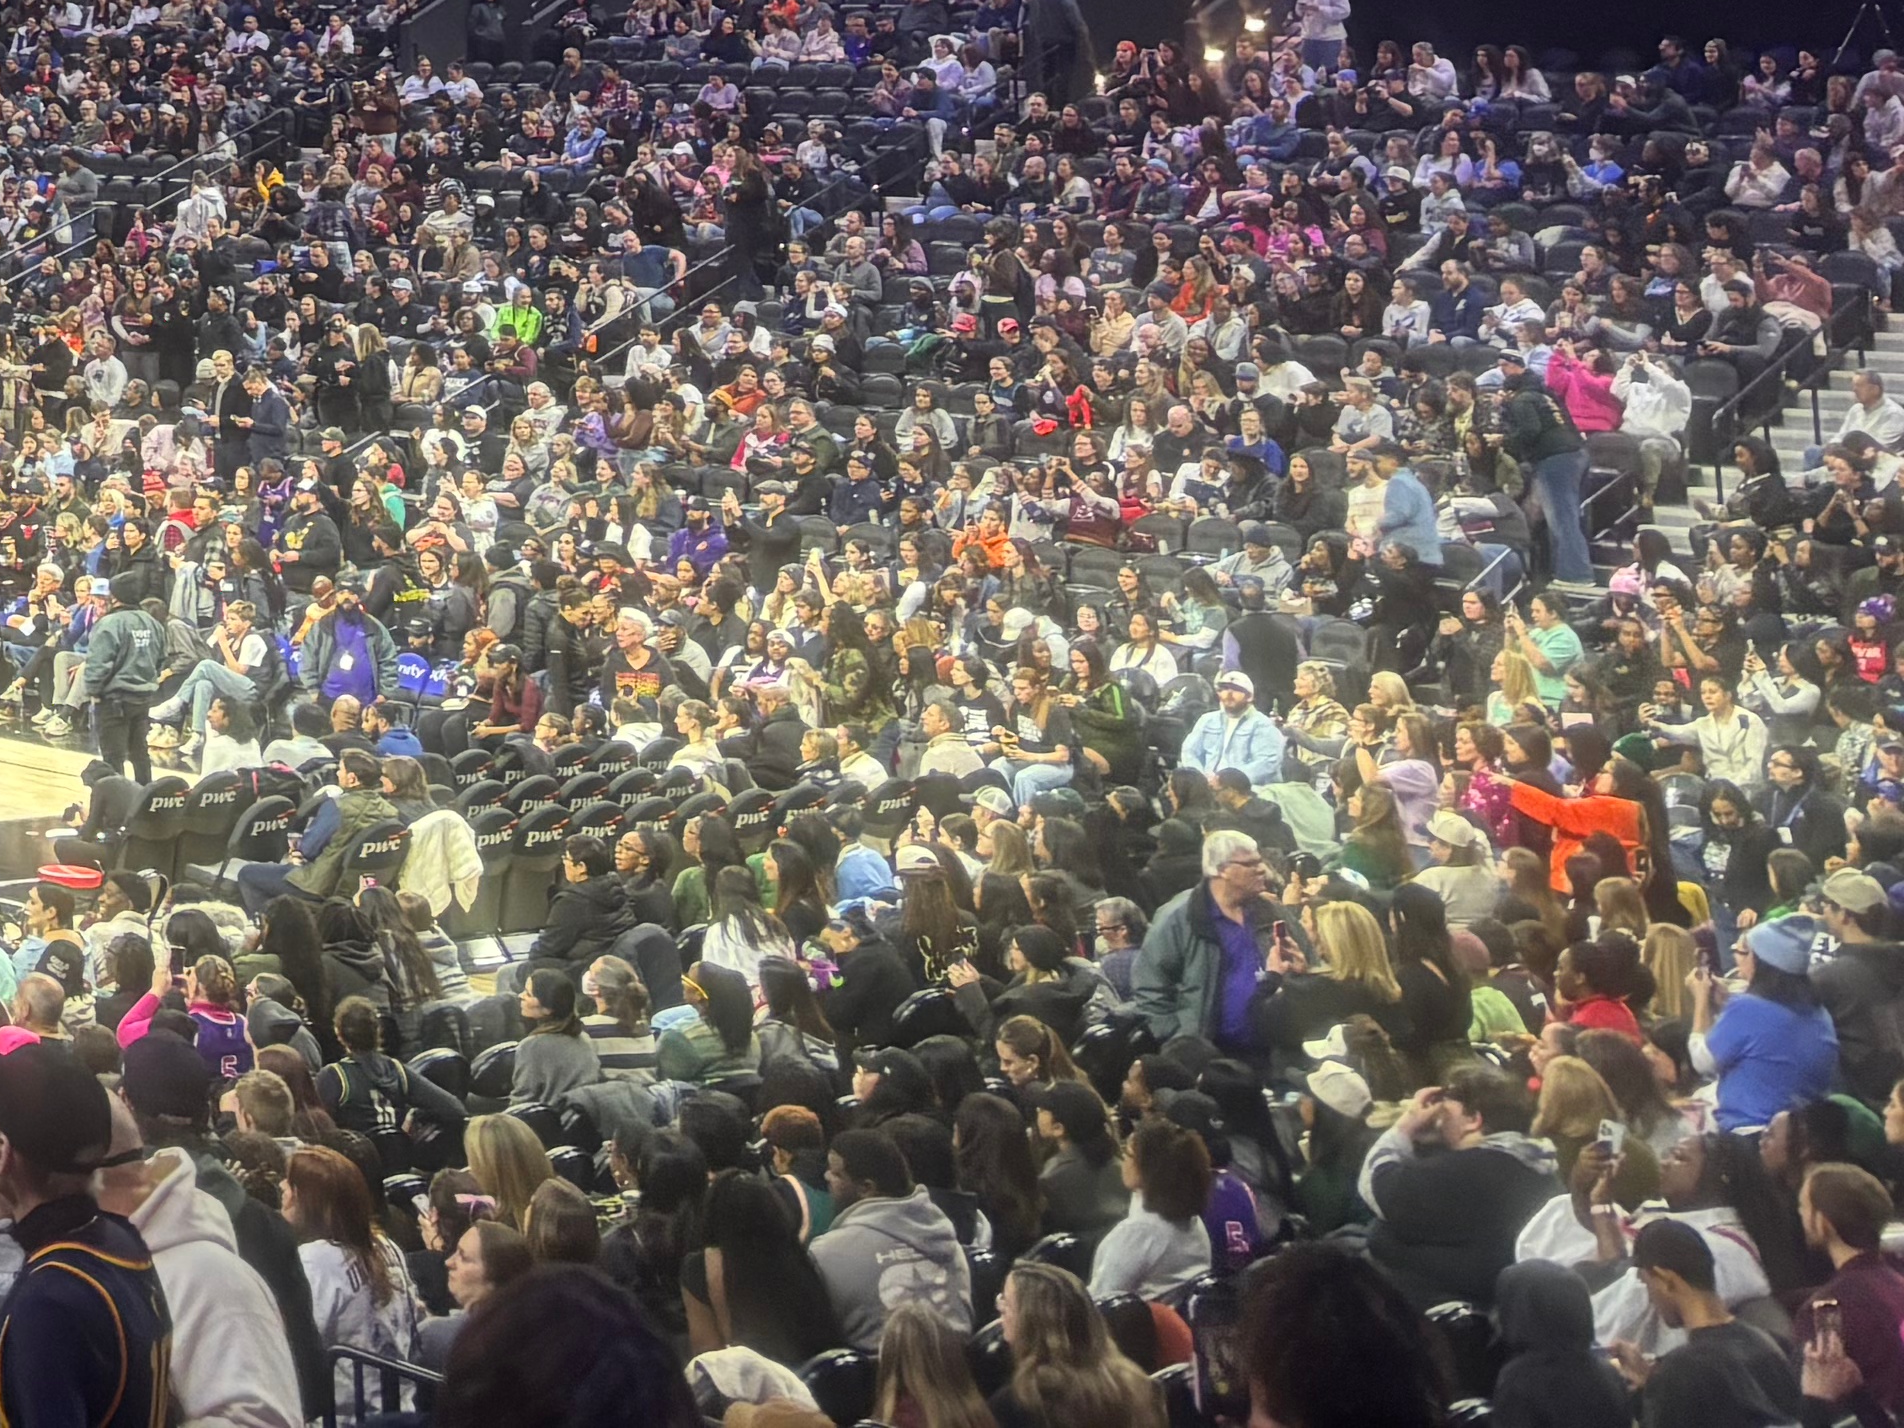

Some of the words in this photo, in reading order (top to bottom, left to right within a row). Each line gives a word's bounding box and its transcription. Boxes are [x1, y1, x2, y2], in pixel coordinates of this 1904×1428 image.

[151, 795, 186, 812] pwc
[200, 790, 237, 808] pwc
[877, 795, 911, 813] pwc
[251, 816, 288, 835] pwc
[735, 810, 769, 829] pwc
[477, 827, 512, 849] pwc
[524, 826, 563, 847] pwc
[360, 838, 401, 857] pwc
